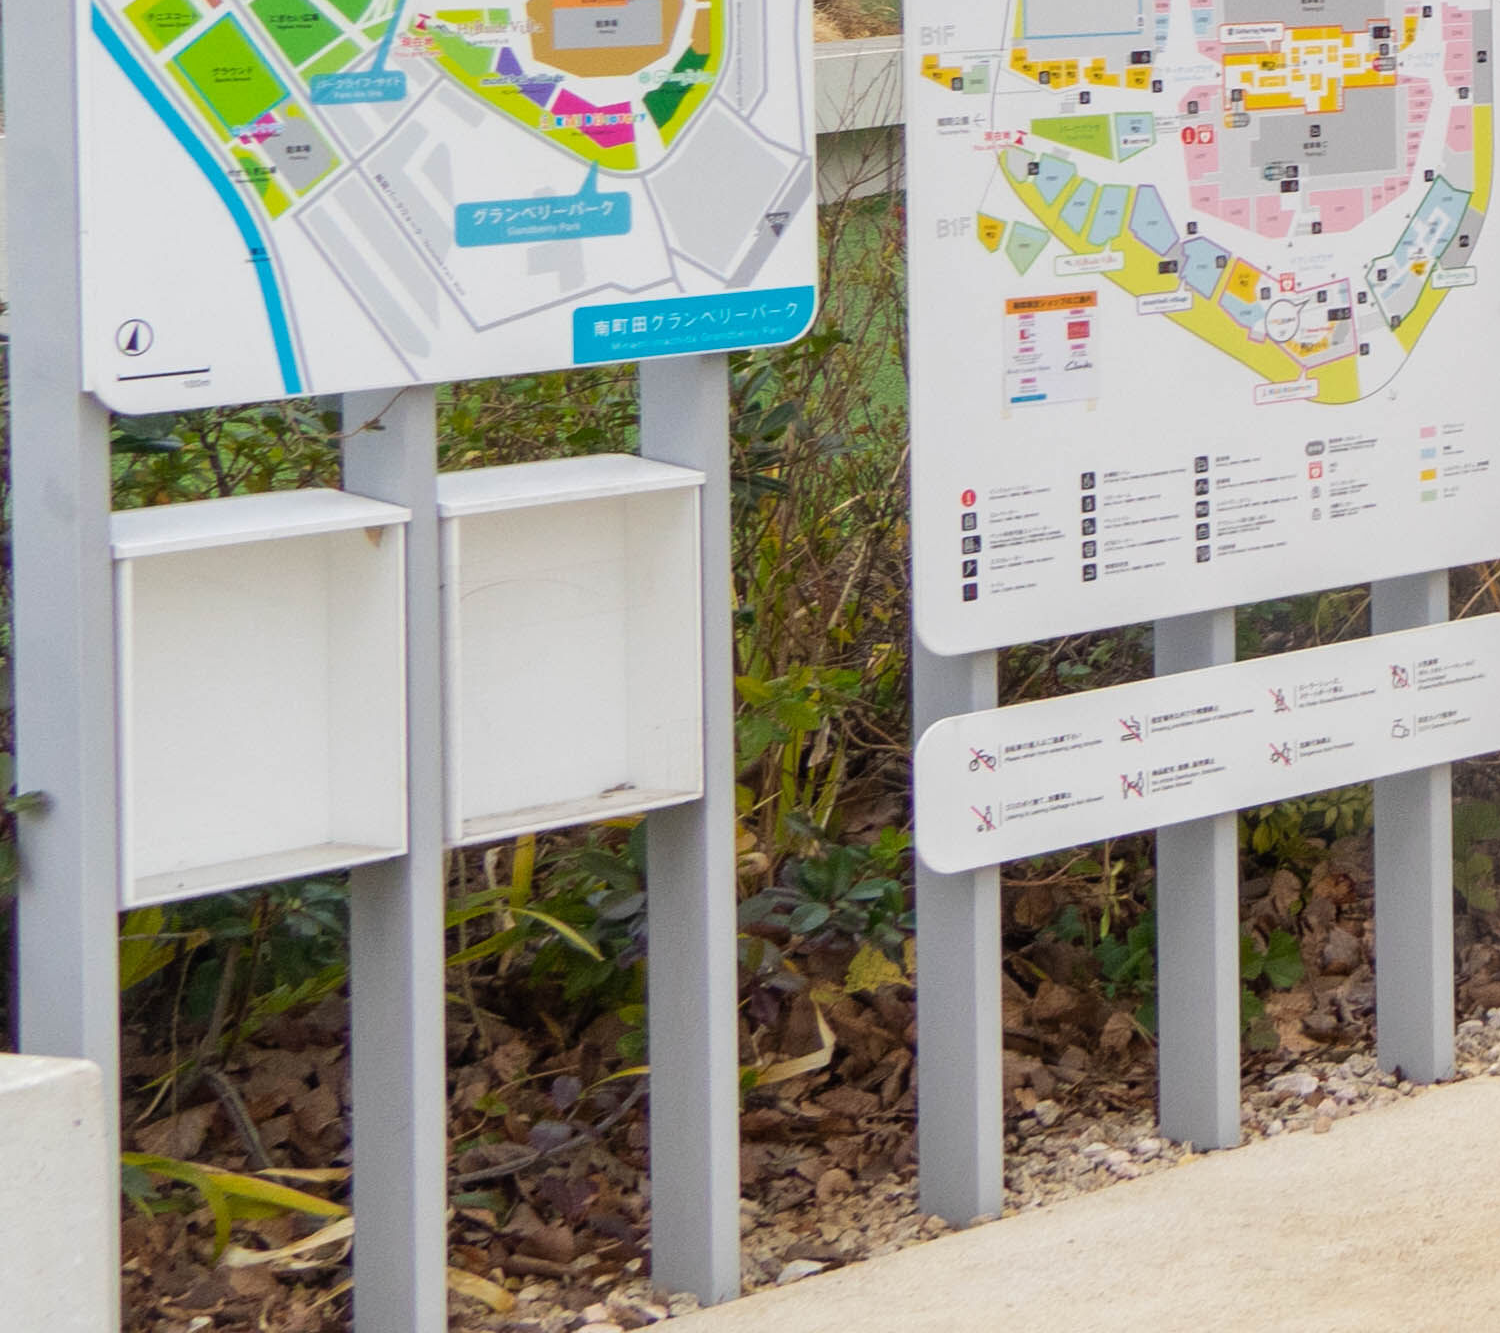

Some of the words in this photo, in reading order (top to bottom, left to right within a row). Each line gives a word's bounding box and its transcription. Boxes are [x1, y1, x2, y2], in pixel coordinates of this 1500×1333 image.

[472, 199, 615, 226] グランベリーパーク
[593, 302, 799, 338] 南町田グランベリーパーク
